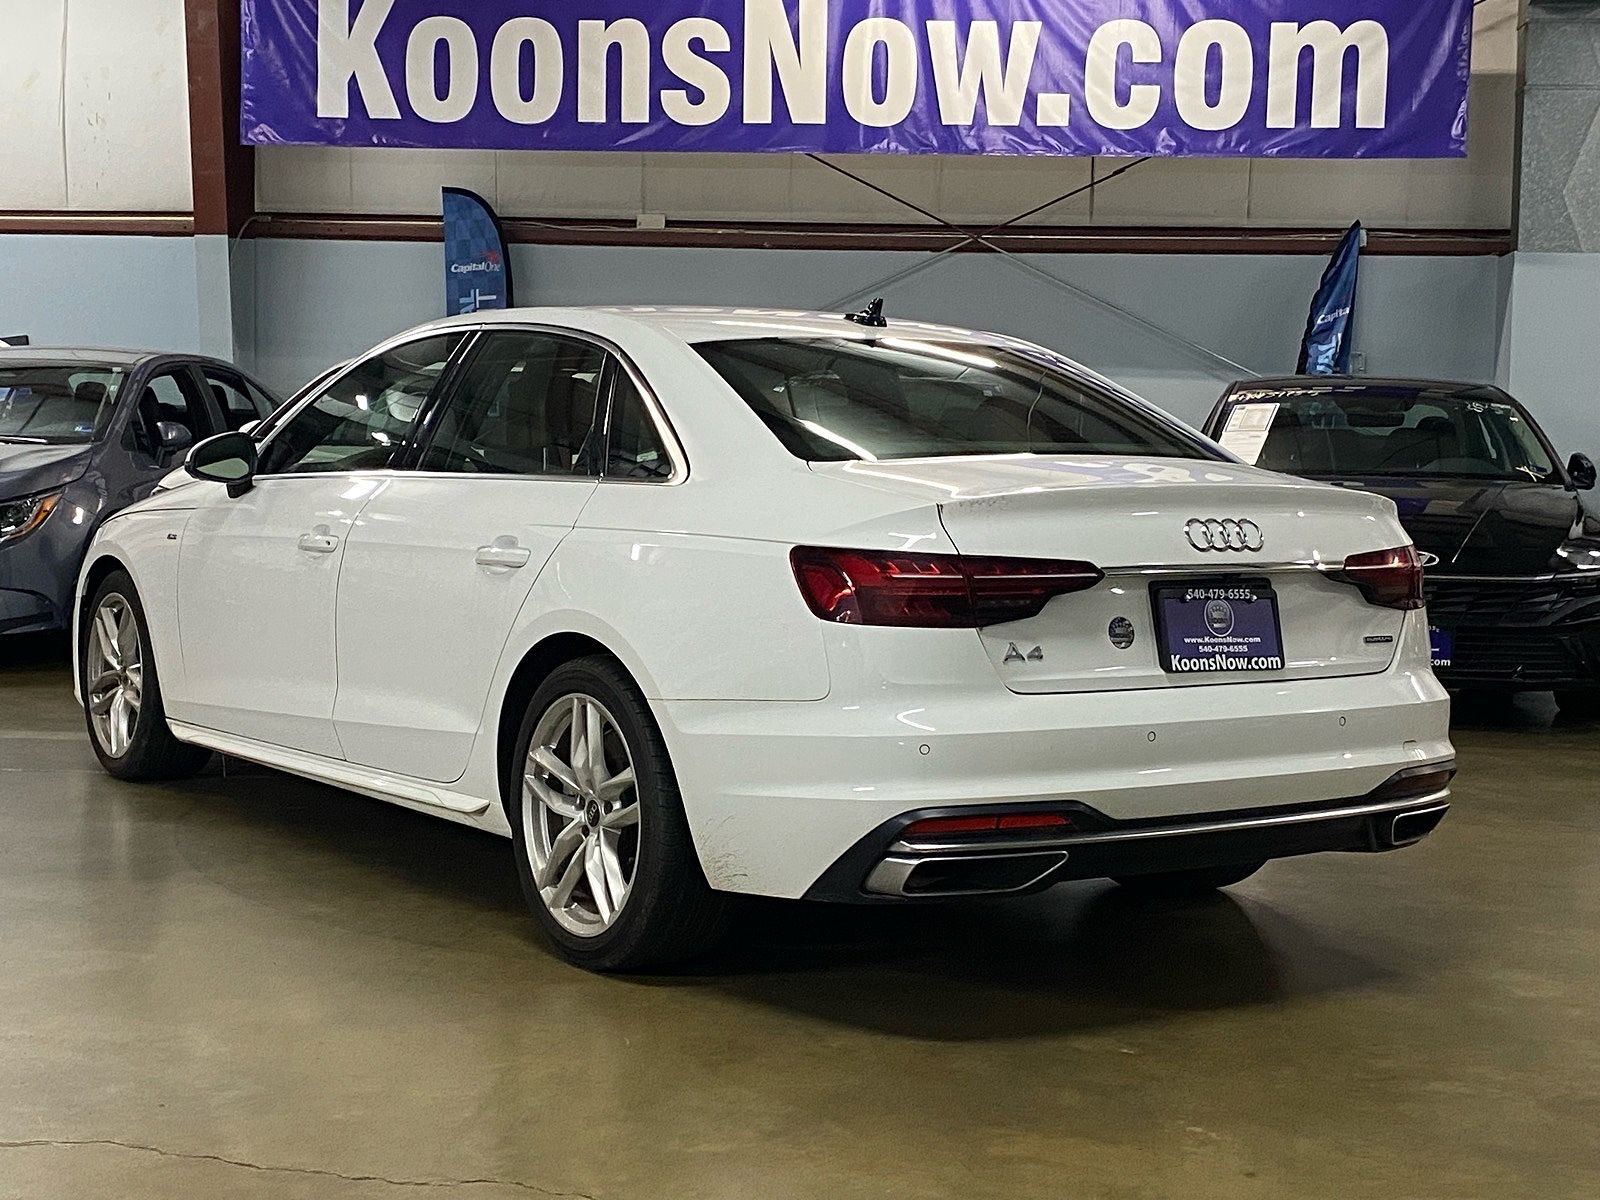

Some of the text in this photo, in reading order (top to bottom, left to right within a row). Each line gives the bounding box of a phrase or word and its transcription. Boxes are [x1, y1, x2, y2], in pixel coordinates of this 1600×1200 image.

[316, 0, 1389, 131] KoonsNow.com
[1187, 588, 1251, 600] 540-479-6555
[1183, 636, 1261, 644] www.KoonsNow.com
[1002, 641, 1044, 665] A4
[1198, 644, 1249, 653] 540-479-6555
[1170, 654, 1282, 671] KoonsNow.com
